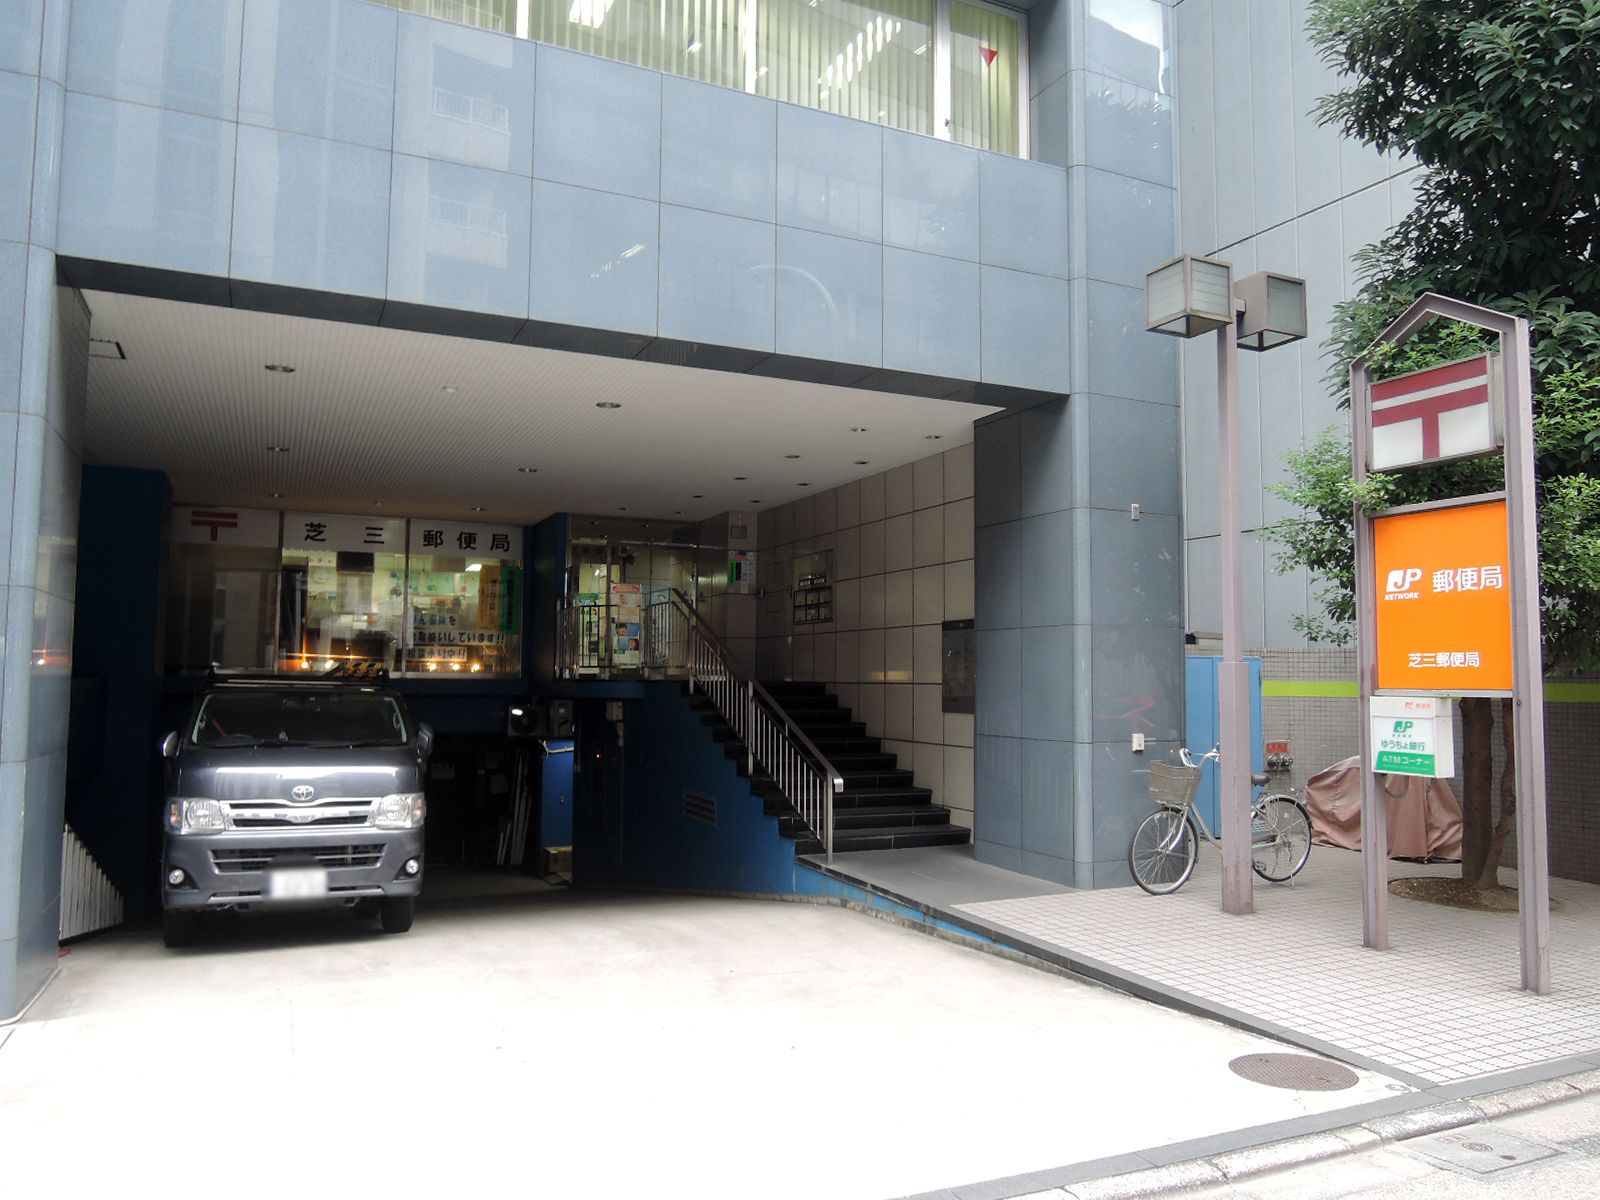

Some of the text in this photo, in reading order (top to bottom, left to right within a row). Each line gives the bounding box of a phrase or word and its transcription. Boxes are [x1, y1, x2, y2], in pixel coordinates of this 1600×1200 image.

[304, 522, 510, 552] 芝三郵便局
[1432, 566, 1503, 593] 郵便局
[1408, 652, 1480, 667] 芝三郵便局
[1381, 739, 1426, 752] ゆうちょ銀行
[1382, 755, 1431, 765] ATMコーナー
